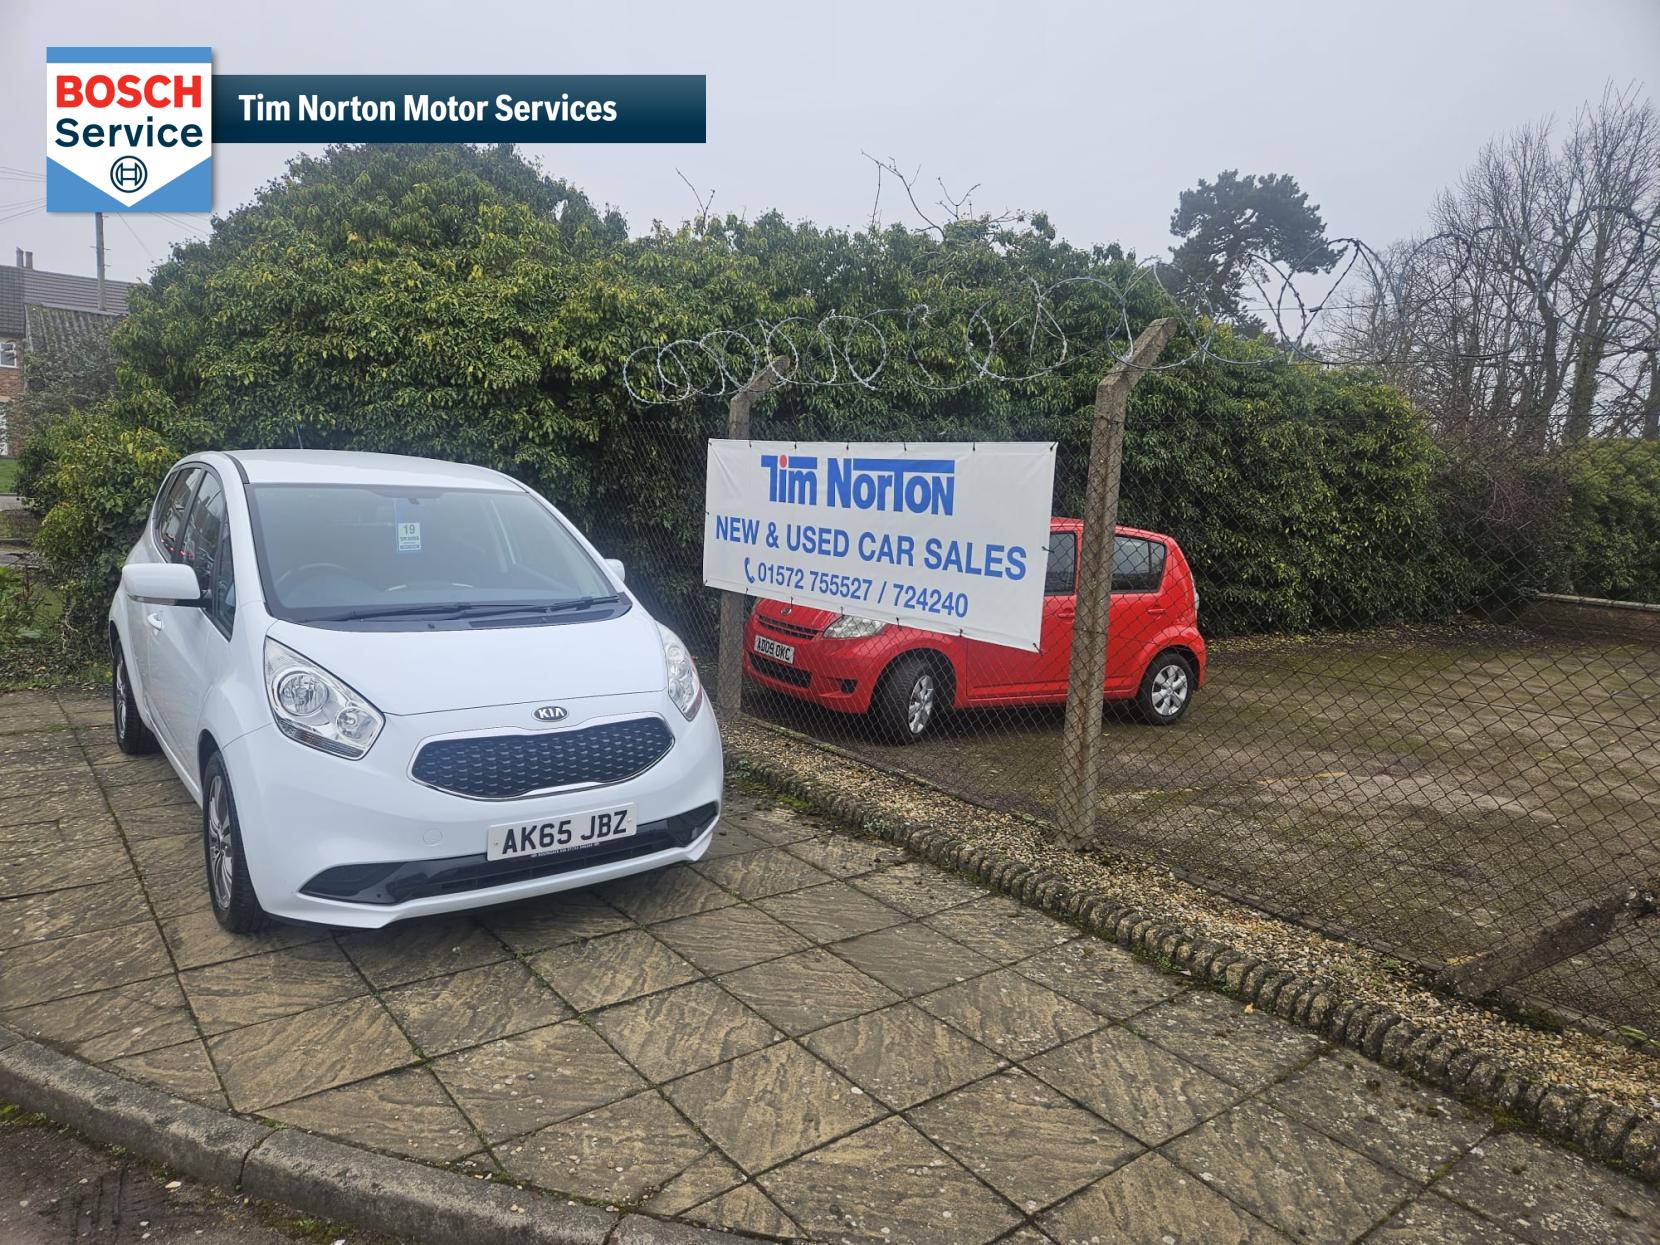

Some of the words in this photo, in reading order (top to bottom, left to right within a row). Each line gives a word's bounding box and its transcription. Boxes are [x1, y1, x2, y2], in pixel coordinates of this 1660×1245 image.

[761, 455, 817, 505] Tim
[716, 515, 760, 545] NEW
[766, 522, 779, 549] &
[787, 525, 849, 558] USED
[858, 532, 914, 567] CAR
[923, 538, 1027, 581] SALES
[758, 562, 804, 590] 01572
[809, 571, 872, 602] 755527
[878, 581, 886, 604] /
[893, 582, 968, 618] 724240
[538, 707, 565, 719] KIA
[502, 820, 572, 855] AK65
[580, 809, 628, 841] JBZ
